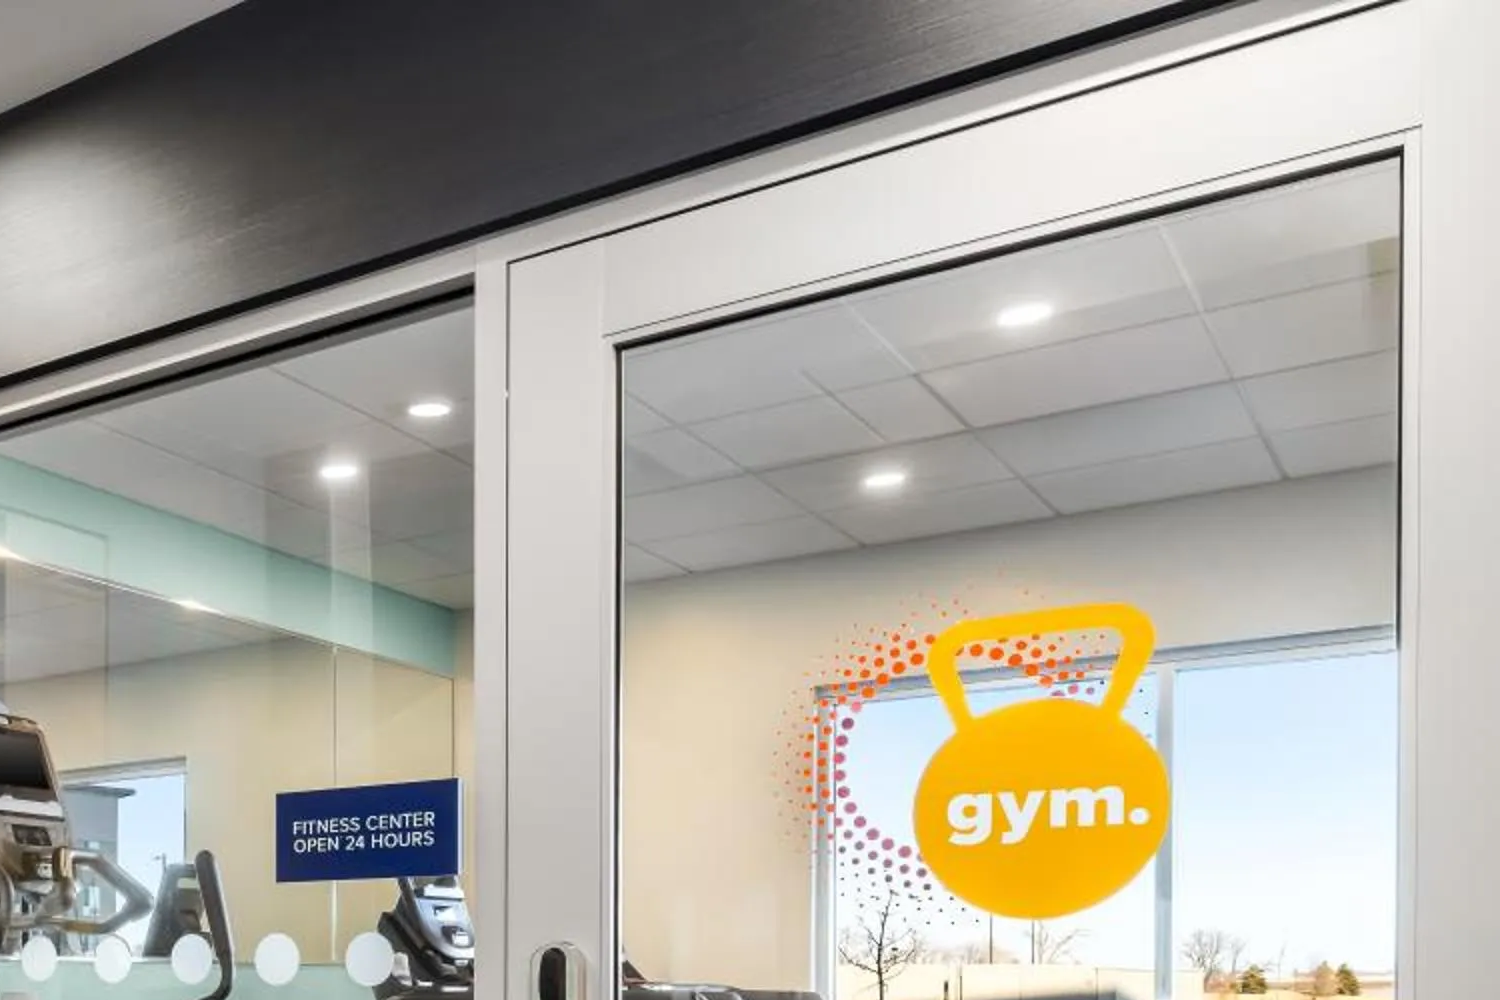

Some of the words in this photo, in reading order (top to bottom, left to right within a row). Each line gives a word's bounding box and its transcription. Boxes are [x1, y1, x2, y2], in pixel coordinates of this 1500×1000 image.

[293, 817, 360, 835] FITNESS
[365, 811, 435, 831] CENTER
[947, 785, 1150, 846] gym.
[293, 837, 339, 853] OPEN
[345, 835, 365, 851] 24
[371, 831, 435, 848] HOURS
